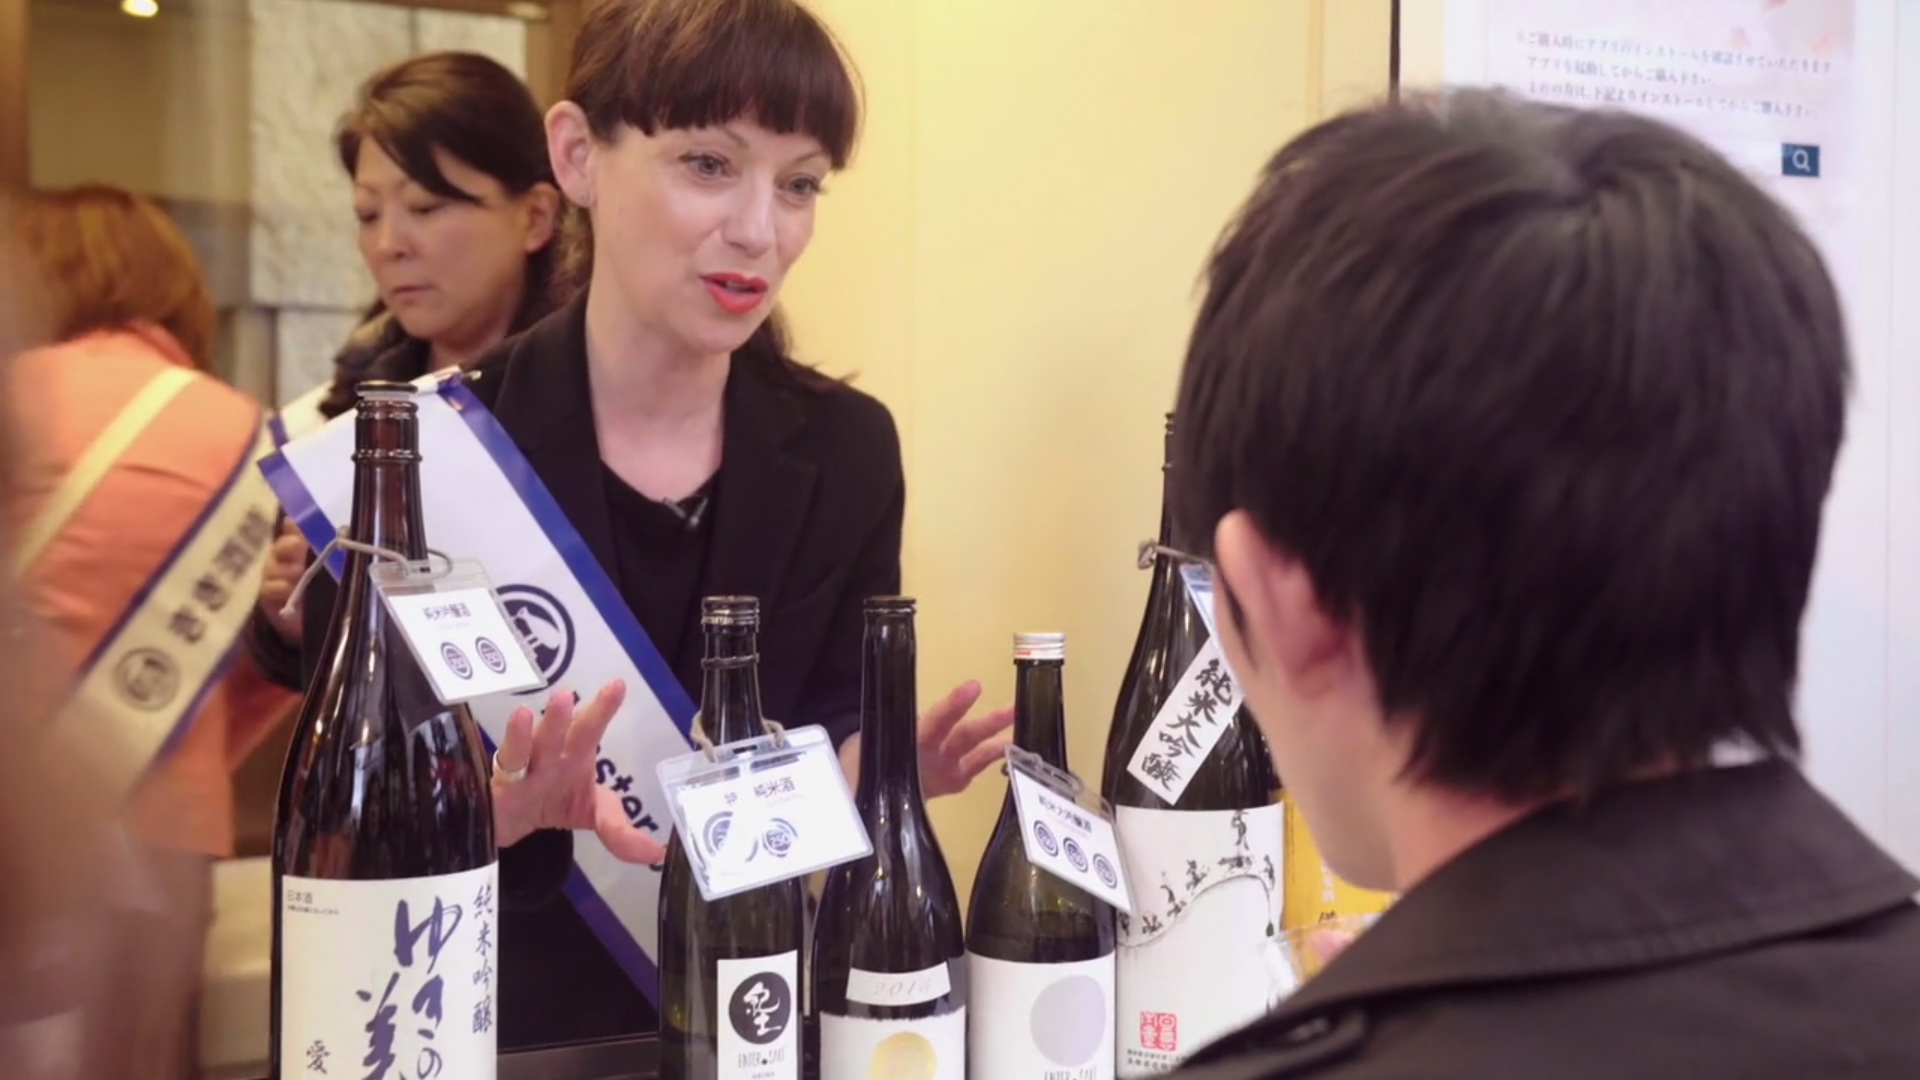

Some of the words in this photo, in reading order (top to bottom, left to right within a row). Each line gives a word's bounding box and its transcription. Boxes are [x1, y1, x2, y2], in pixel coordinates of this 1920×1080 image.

[1141, 658, 1232, 792] 純米大吟醸
[724, 776, 796, 805] 特純米酒
[473, 880, 494, 1034] 純米吟醸
[306, 1039, 331, 1075] 愛
